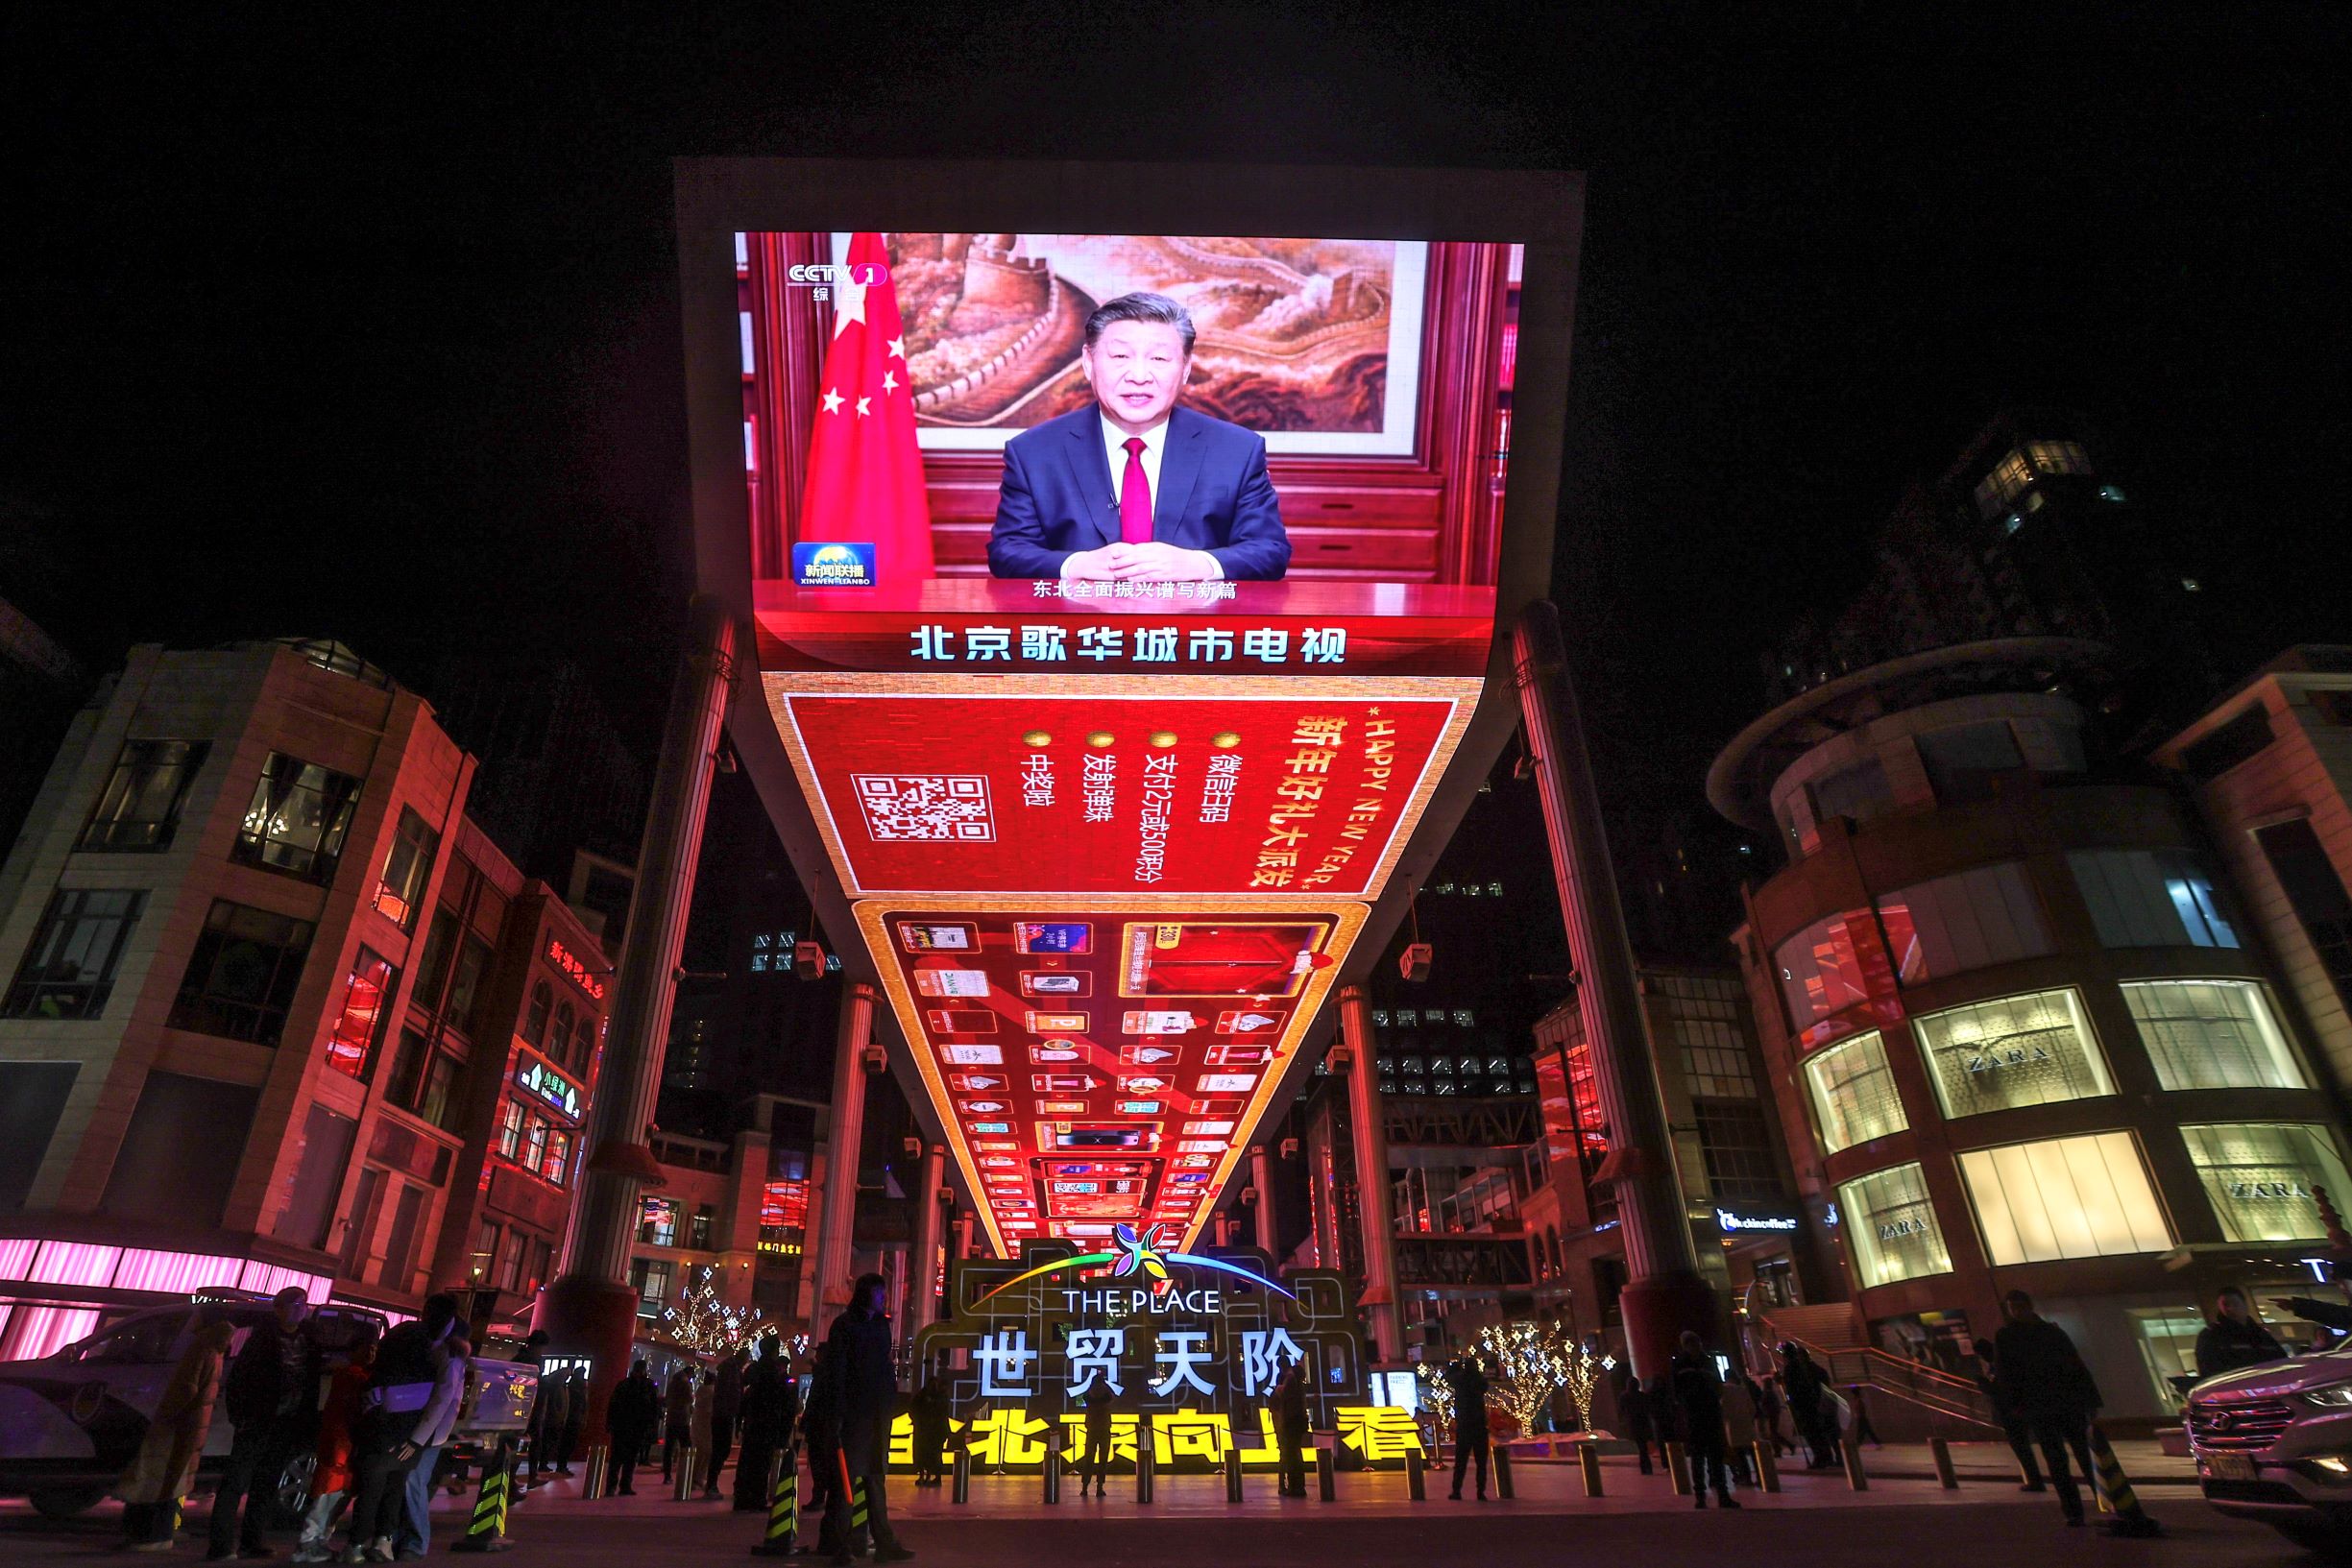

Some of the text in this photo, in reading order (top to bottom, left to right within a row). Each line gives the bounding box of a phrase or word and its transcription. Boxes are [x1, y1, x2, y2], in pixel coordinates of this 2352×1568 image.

[788, 264, 852, 282] CCTV
[805, 564, 864, 578] 新闻联播
[1032, 579, 1238, 600] 东北全面振兴谱写新篇
[909, 624, 1347, 664] 北京歌华城市电视
[1020, 754, 1055, 807] 中奖啦
[1082, 754, 1117, 823] 发射弹珠
[1199, 754, 1244, 823] 微信扫码
[1135, 754, 1179, 883] 支付2元或500积分
[1250, 715, 1348, 888] 新年好礼大派发
[1304, 719, 1395, 884] HAPPY NEW YEAR
[1968, 1047, 2052, 1073] ZARA
[2228, 1182, 2310, 1198] ZARA
[1880, 1217, 1928, 1241] ZARA
[1061, 1289, 1220, 1314] THE PLACE
[972, 1326, 1304, 1398] 世贸天阶
